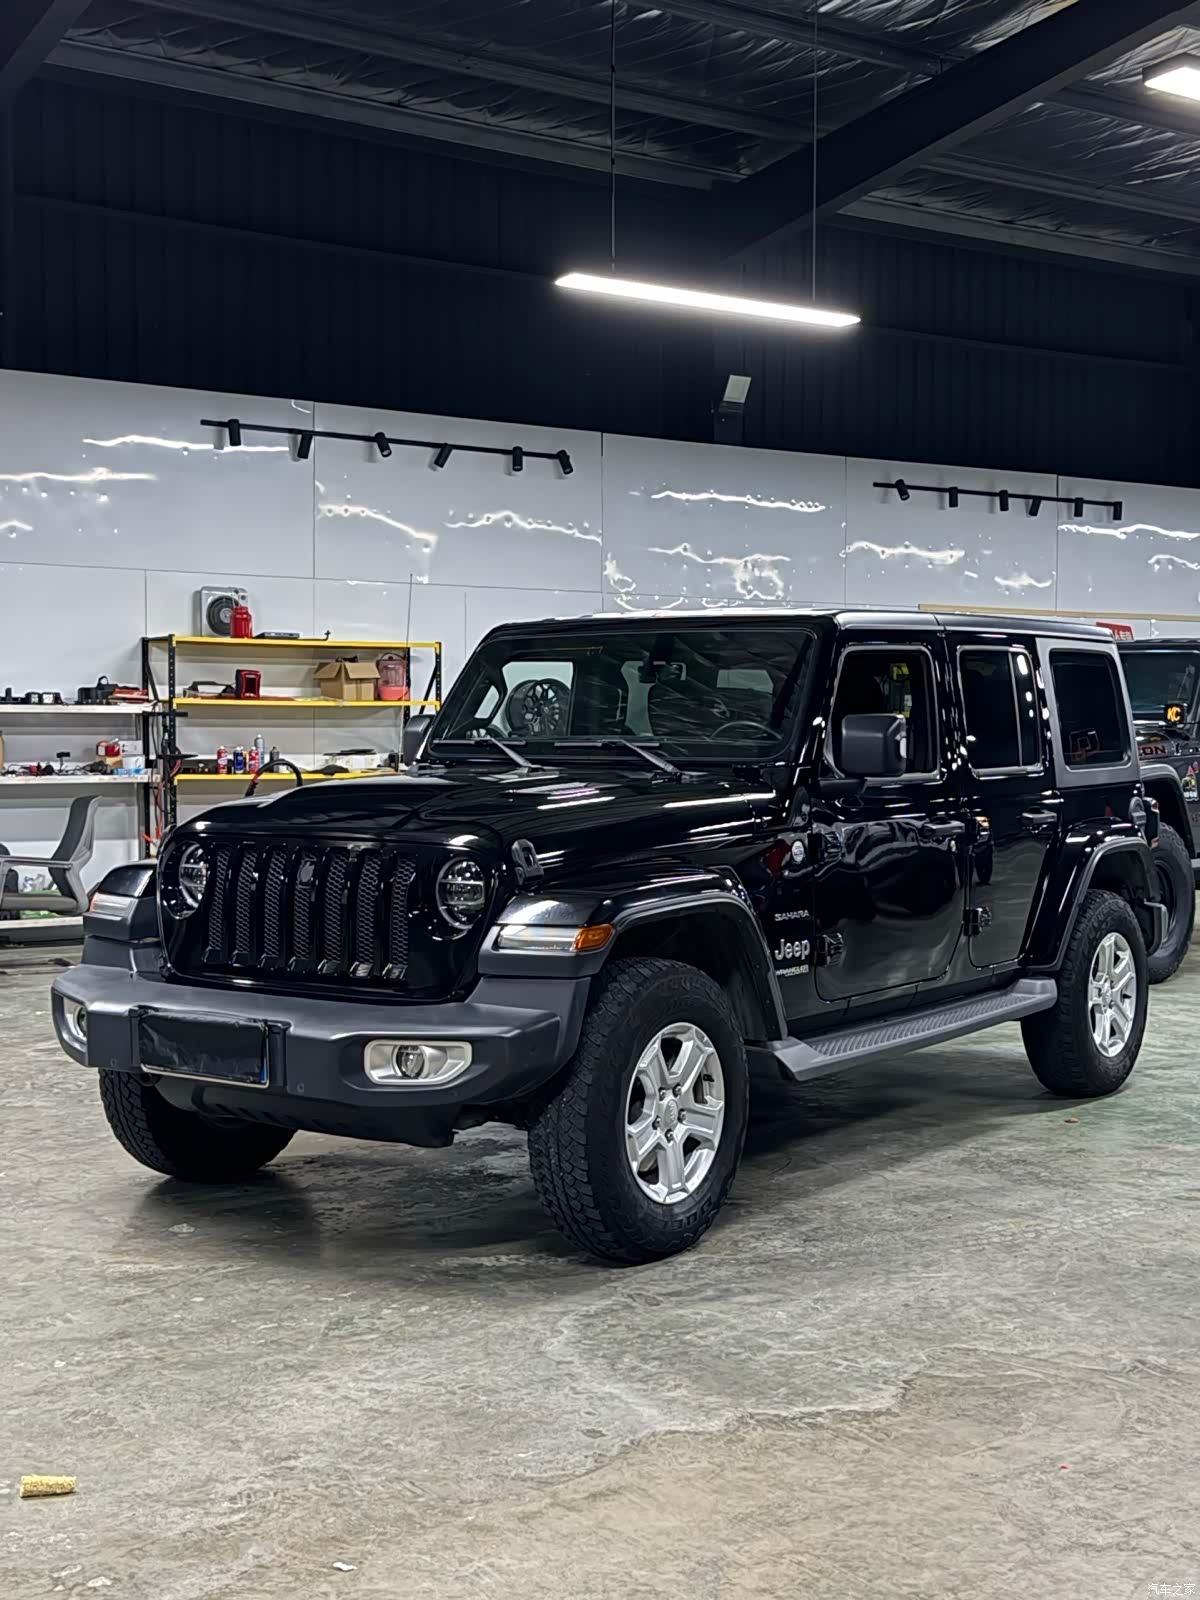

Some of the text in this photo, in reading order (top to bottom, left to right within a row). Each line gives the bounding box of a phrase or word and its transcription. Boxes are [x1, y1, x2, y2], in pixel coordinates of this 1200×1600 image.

[1166, 706, 1181, 721] KC
[1139, 744, 1167, 757] ON
[774, 910, 810, 921] SAHARA
[774, 938, 810, 960] Jeep
